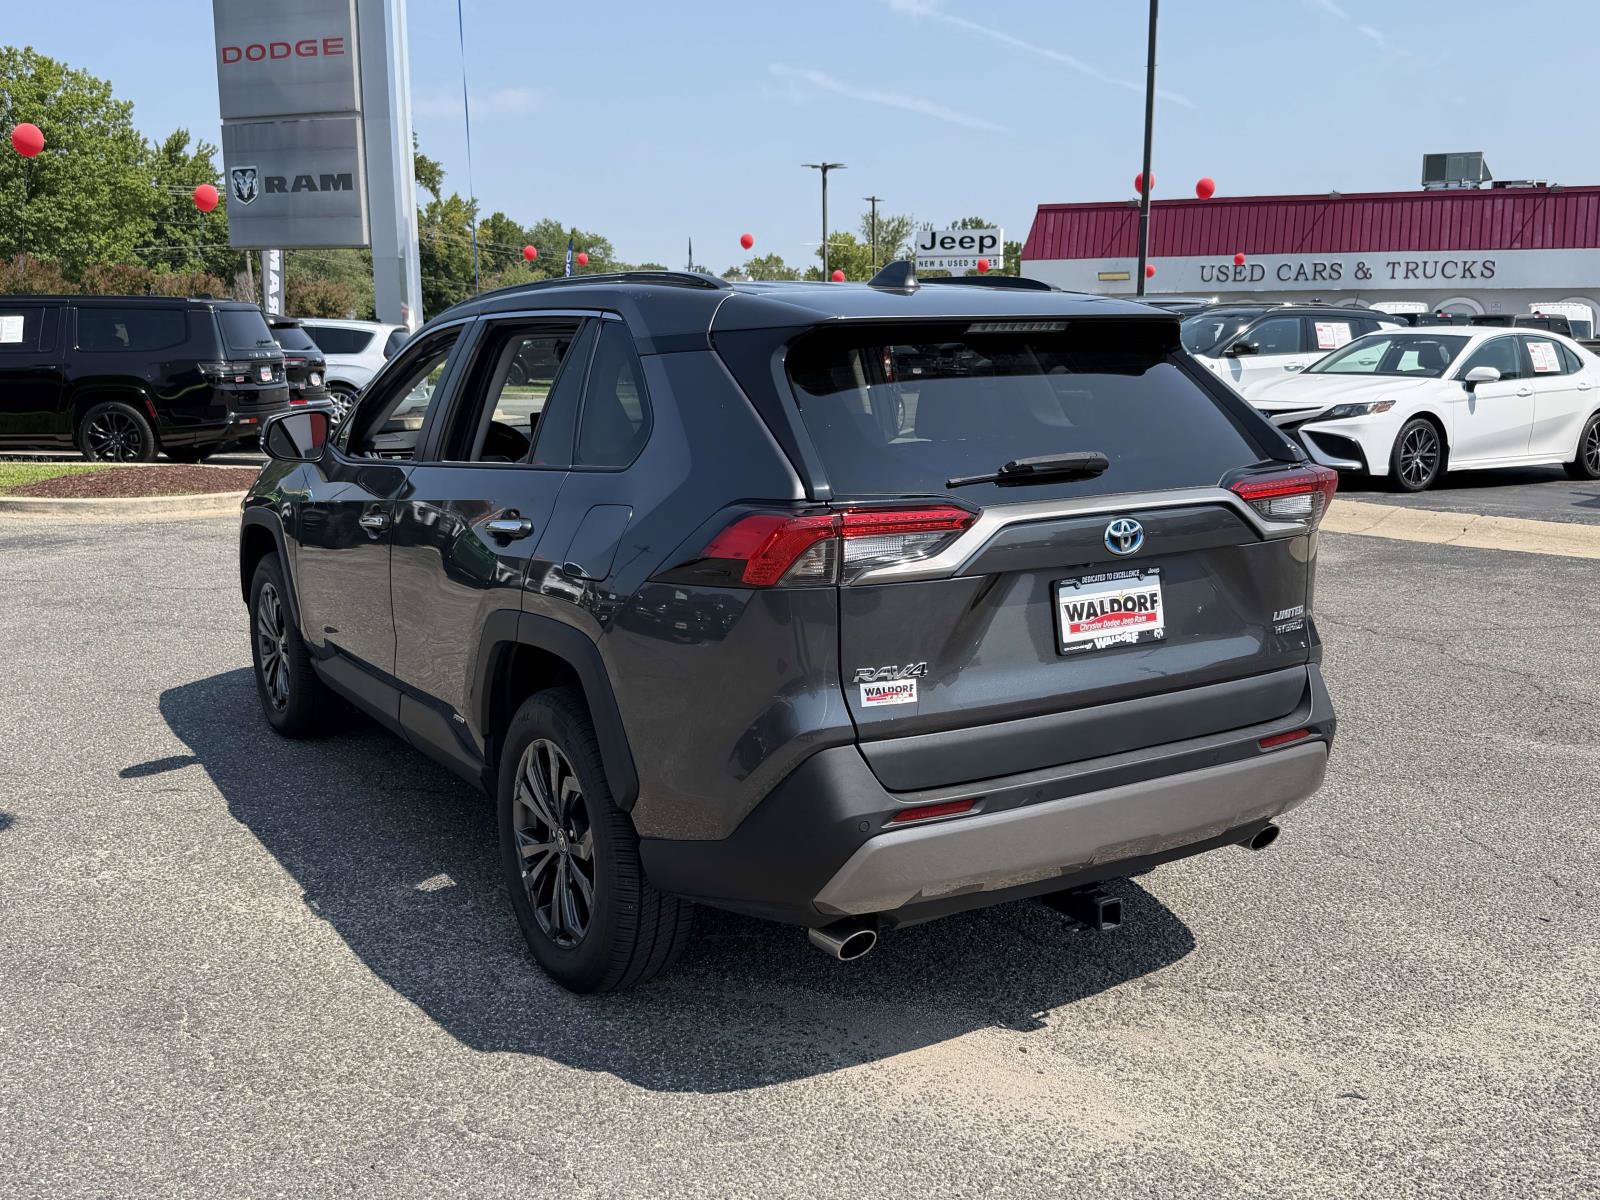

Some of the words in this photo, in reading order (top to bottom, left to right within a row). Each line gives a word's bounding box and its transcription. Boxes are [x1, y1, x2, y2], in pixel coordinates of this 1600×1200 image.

[222, 37, 345, 64] DODGE
[264, 173, 353, 194] RAM
[920, 231, 997, 253] Jeep
[938, 259, 944, 267] &
[947, 259, 969, 267] USED
[972, 258, 998, 266] SES
[1200, 263, 1266, 283] USED
[1276, 262, 1343, 281] CARS
[1354, 262, 1373, 280] &
[1386, 259, 1496, 280] TRUCKS
[1081, 573, 1106, 584] DEDICATED
[1106, 572, 1113, 581] TO
[1113, 569, 1140, 580] EXCELLENCE
[1063, 592, 1158, 623] WALDORF
[1079, 621, 1103, 632] Chrysler
[1103, 618, 1121, 629] Dodge
[1121, 617, 1135, 626] Jeep
[1134, 615, 1147, 624] Ram
[1094, 632, 1139, 649] WALDORF
[852, 661, 929, 683] RAV4
[864, 684, 914, 696] WALDORF
